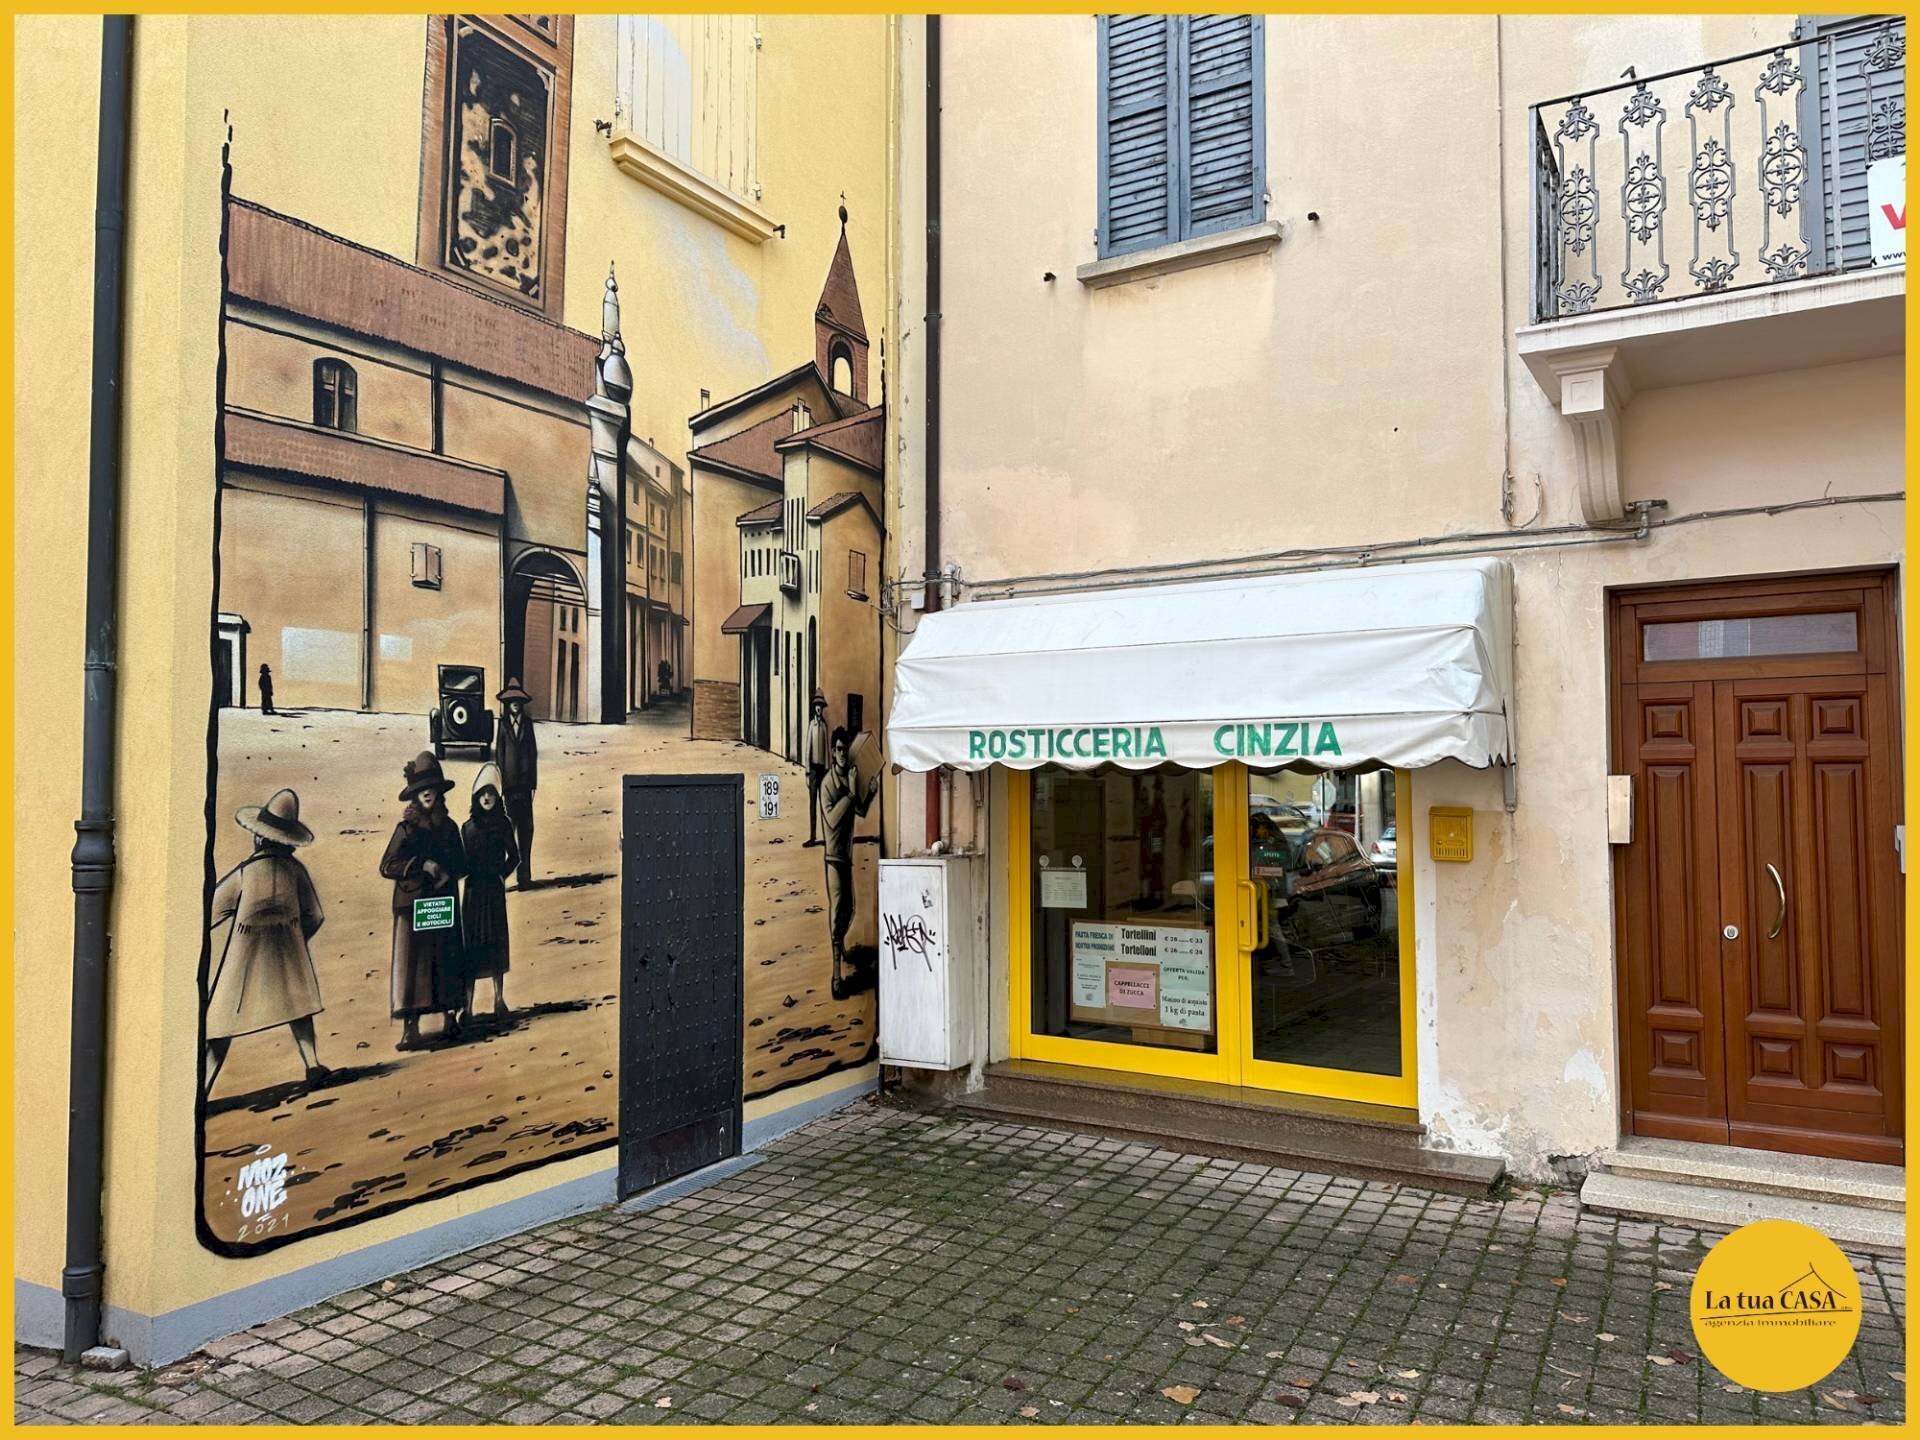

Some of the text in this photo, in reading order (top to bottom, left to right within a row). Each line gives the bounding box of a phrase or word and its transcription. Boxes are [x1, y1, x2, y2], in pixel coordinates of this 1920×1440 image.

[968, 721, 1343, 760] ROSTICCERIA CINZIA
[763, 781, 779, 796] 189
[764, 801, 778, 816] 191
[1121, 928, 1156, 940] Tortellini
[1121, 944, 1156, 956] Tortelloni
[1114, 980, 1150, 989] CAPPELLACCI
[1170, 1006, 1178, 1016] kg
[241, 1181, 288, 1218] ONE
[237, 1213, 289, 1242] 2021
